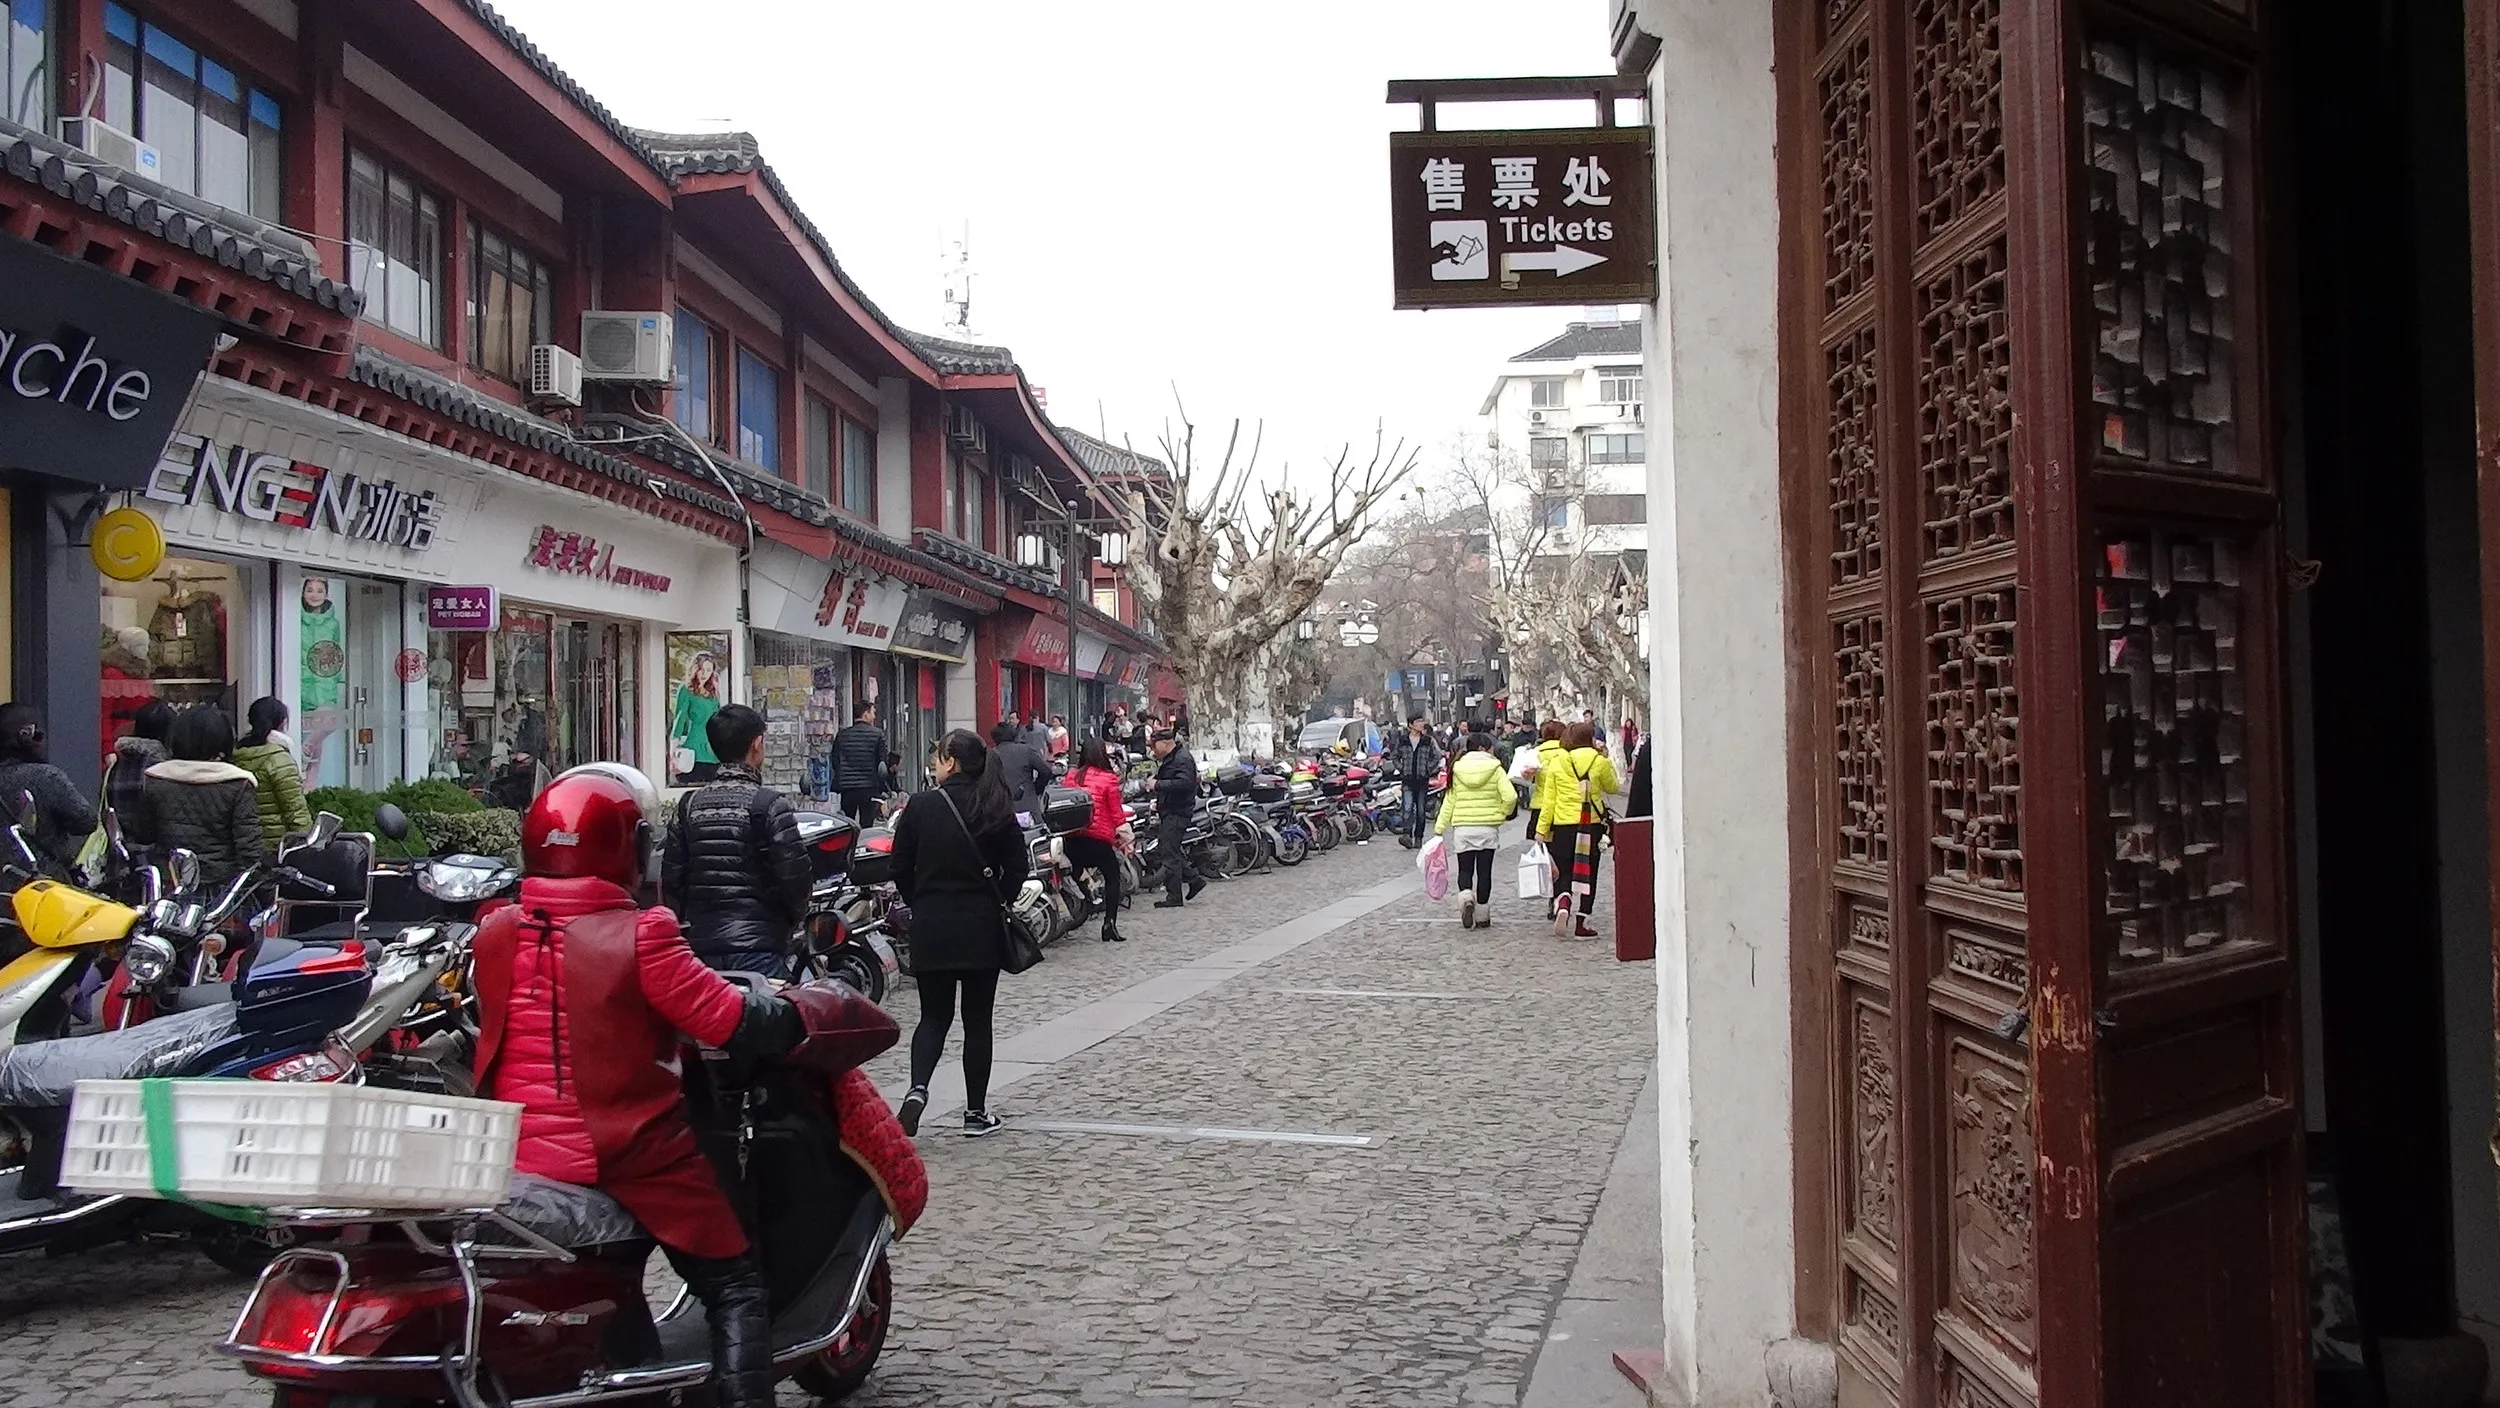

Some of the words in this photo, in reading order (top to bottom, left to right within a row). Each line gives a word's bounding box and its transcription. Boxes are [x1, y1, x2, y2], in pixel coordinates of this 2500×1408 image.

[1419, 155, 1613, 212] 售票处
[1499, 215, 1614, 244] Tickets
[0, 328, 151, 421] che
